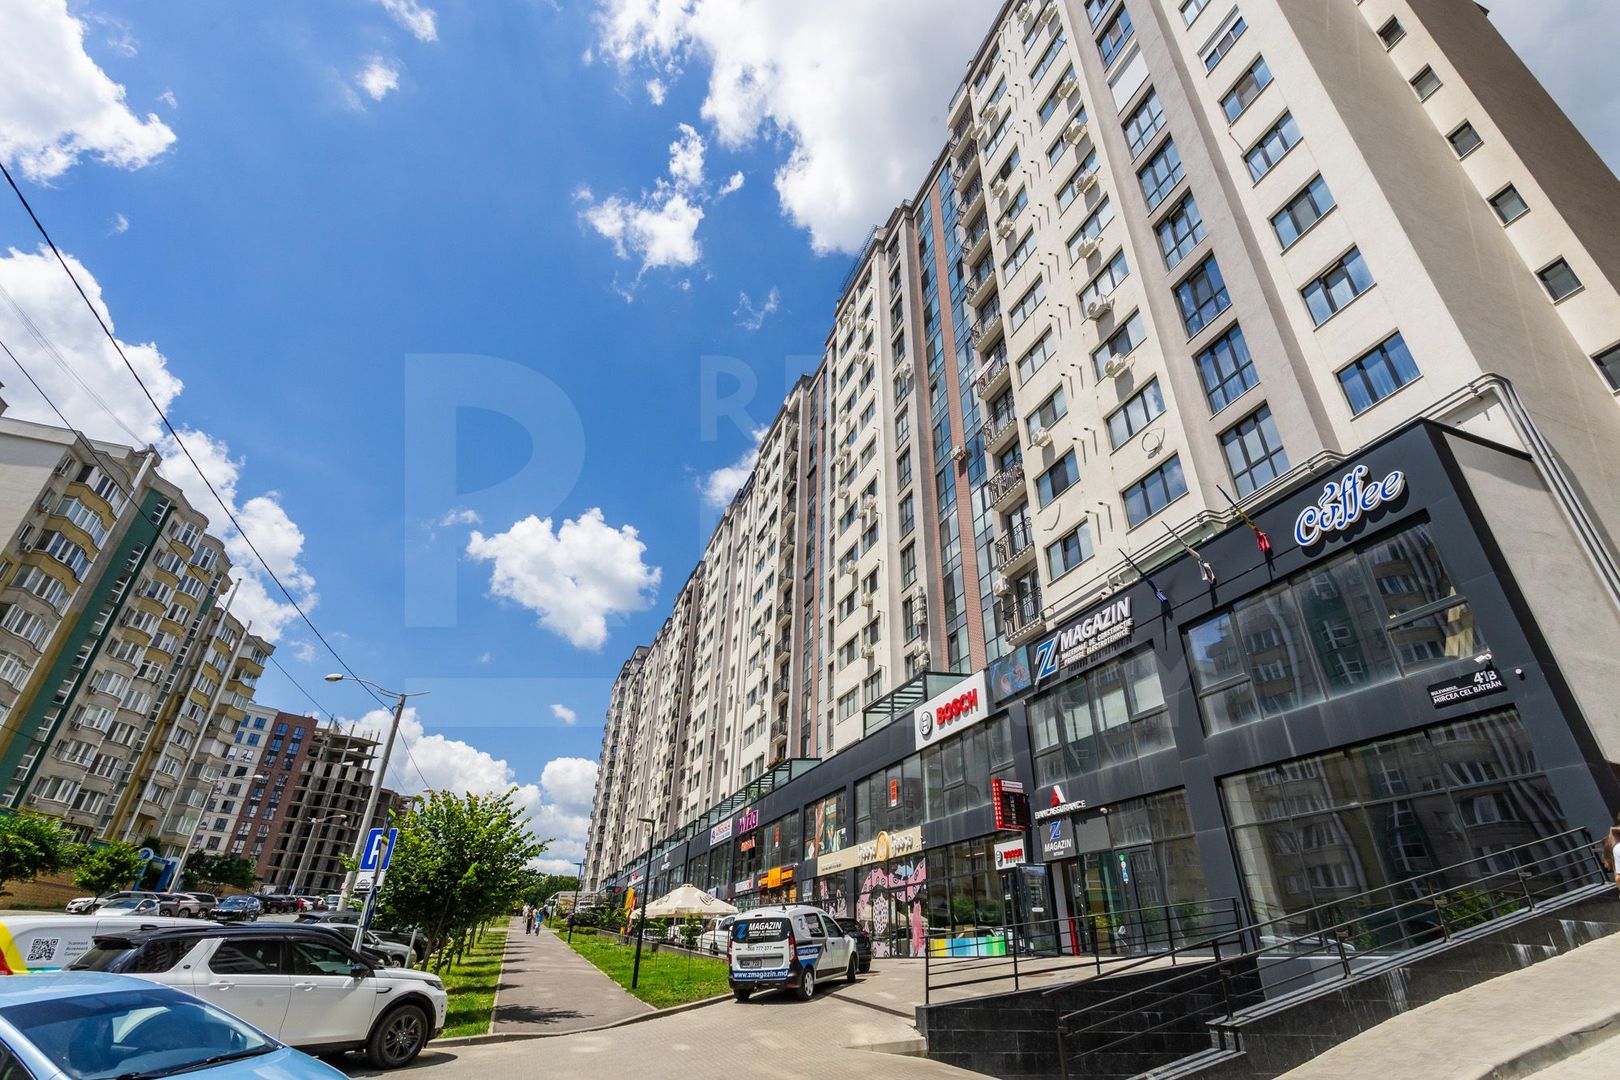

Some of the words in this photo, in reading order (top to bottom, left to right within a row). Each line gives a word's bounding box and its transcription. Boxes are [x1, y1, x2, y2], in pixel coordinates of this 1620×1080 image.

[1294, 464, 1404, 546] Coffee
[1061, 596, 1131, 651] MAGAZIN
[1473, 670, 1497, 684] 41B
[1433, 691, 1460, 704] MIRCEA
[1459, 688, 1475, 698] CEL
[1473, 680, 1503, 694] BĂTRÂN
[935, 687, 979, 726] BOSCH
[1034, 800, 1087, 820] BANCASSURANCE
[1044, 838, 1072, 853] MAGAZIN
[748, 921, 783, 931] MAGAZIN
[733, 969, 789, 978] www.zmagazin.md
